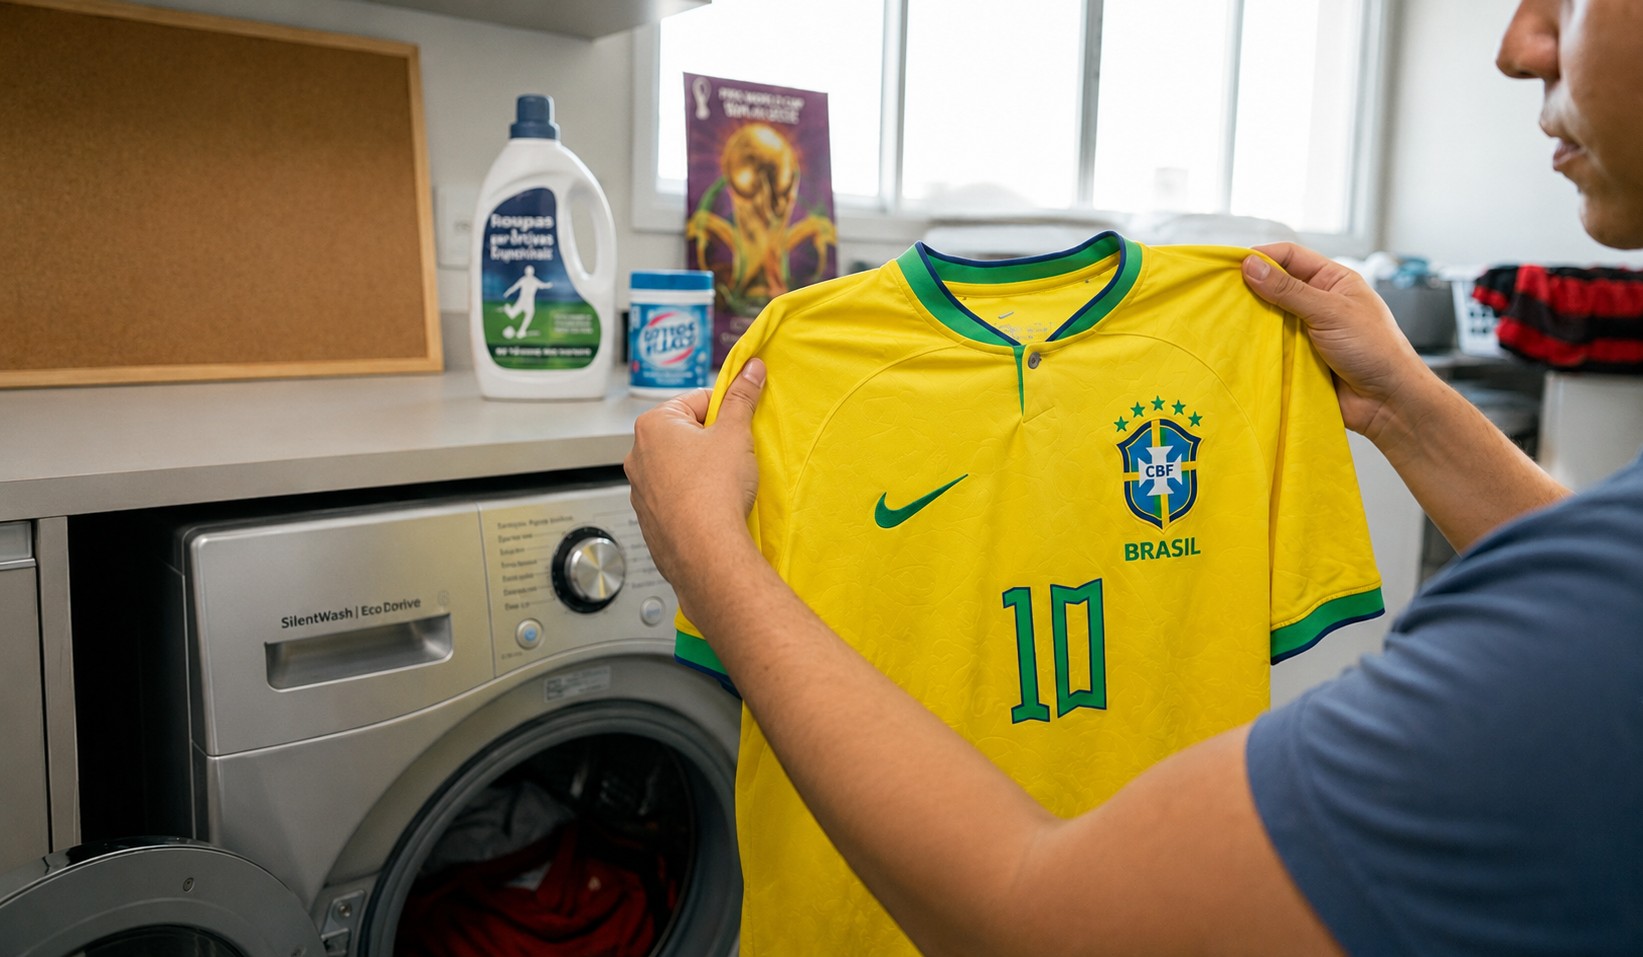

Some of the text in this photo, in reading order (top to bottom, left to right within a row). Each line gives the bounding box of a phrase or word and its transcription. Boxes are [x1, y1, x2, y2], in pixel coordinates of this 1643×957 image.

[1145, 464, 1174, 478] CBF
[1124, 537, 1201, 561] BRASIL
[281, 607, 353, 629] SilentWash
[1002, 578, 1107, 724] 10
